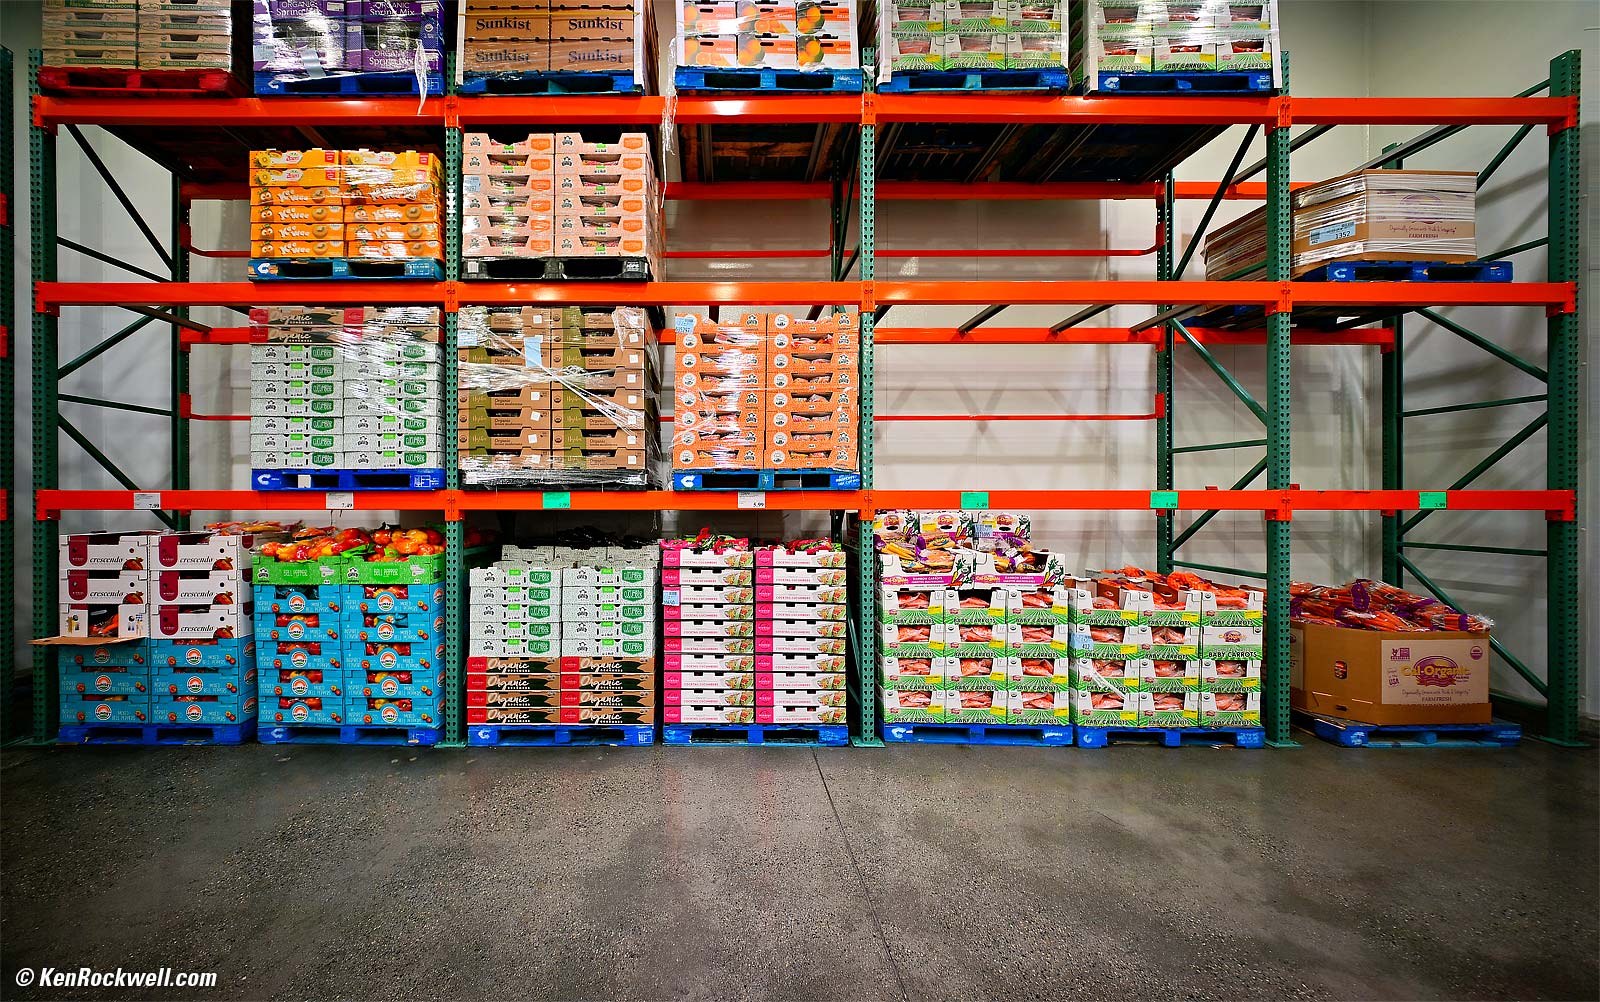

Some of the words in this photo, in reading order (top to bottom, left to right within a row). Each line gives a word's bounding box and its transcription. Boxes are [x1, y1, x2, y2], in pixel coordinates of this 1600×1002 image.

[476, 17, 531, 31] Sunkist
[569, 17, 623, 31] Sunkist
[475, 49, 529, 63] Sunkist
[568, 50, 623, 63] Sunkist
[1335, 231, 1350, 240] 1352
[488, 658, 529, 672] Organic
[580, 658, 622, 672] Organic
[1401, 665, 1470, 679] Cal-Organic
[488, 675, 529, 689] Organic
[580, 675, 622, 689] Organic
[488, 692, 529, 706] Organic
[580, 692, 622, 706] Organic
[488, 709, 529, 724] Organic
[580, 709, 622, 724] Organic
